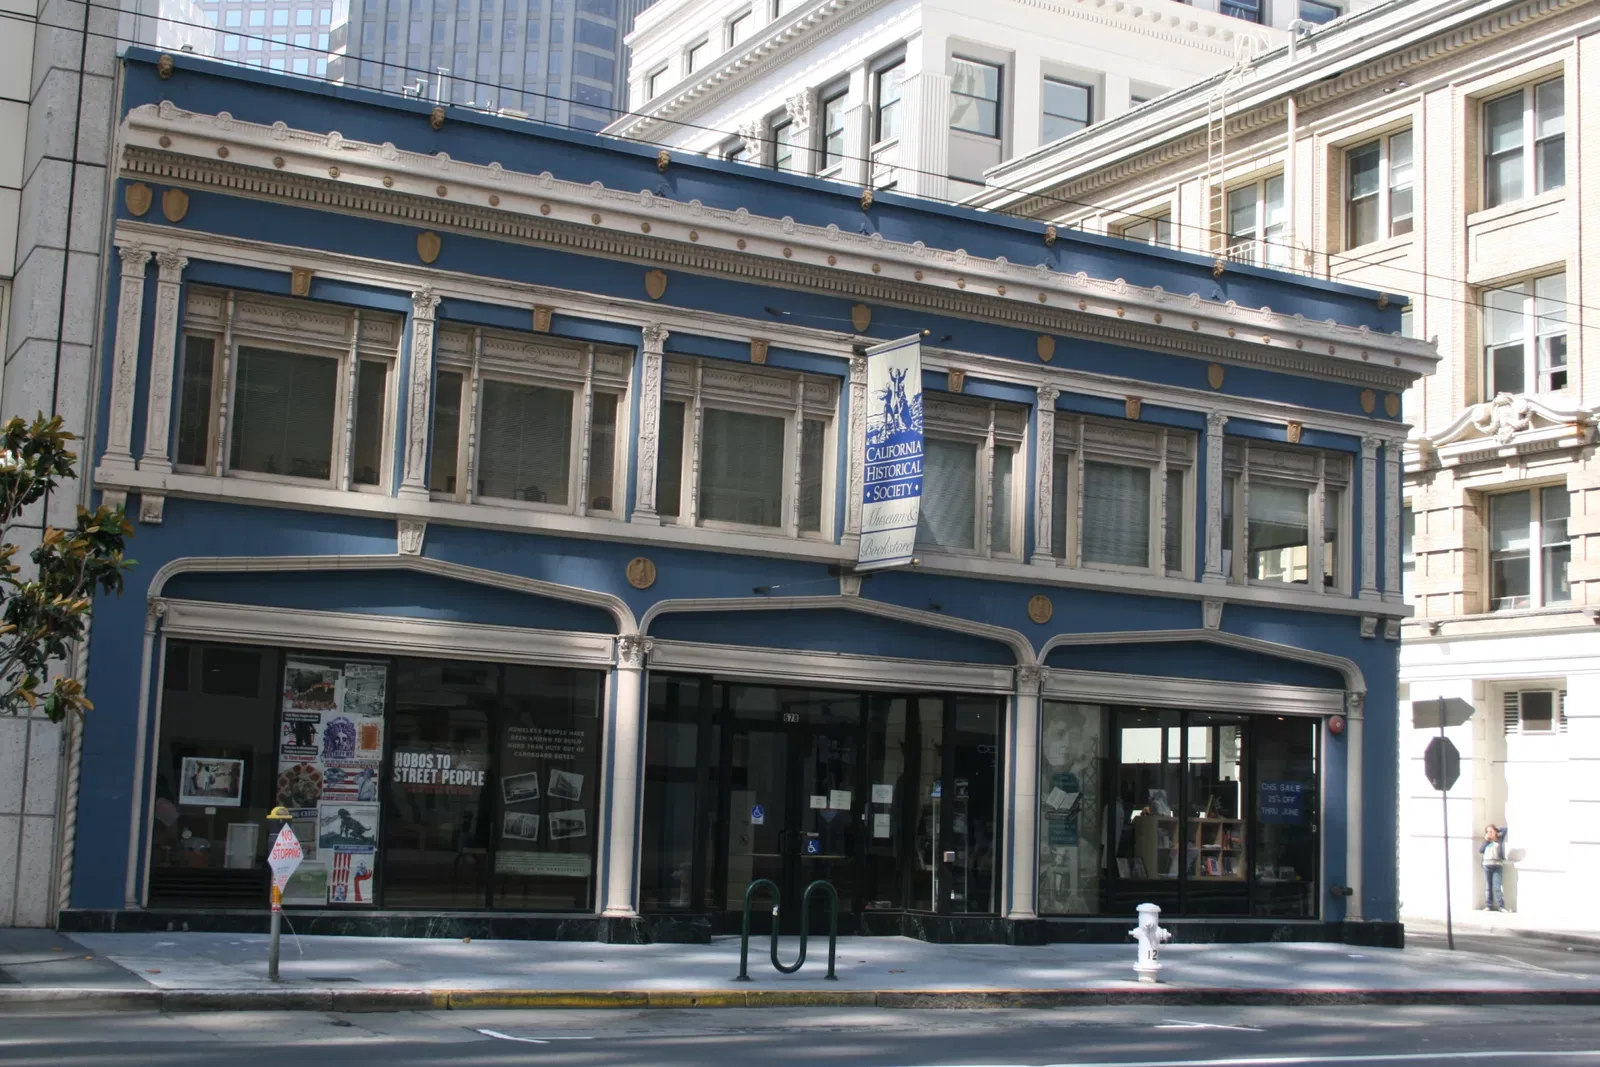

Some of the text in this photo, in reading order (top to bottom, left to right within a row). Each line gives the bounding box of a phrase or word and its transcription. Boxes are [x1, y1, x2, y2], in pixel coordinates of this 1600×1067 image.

[866, 440, 922, 462] CALIFORNIA
[866, 460, 922, 482] HISTORICAL
[873, 482, 913, 501] SOCIETY
[862, 506, 918, 528] Museum &
[860, 536, 913, 557] Bookstore
[784, 713, 799, 723] 678
[508, 727, 542, 735] HOMELESS
[544, 728, 567, 736] PEOPLE
[394, 752, 451, 769] HOBOS TO
[393, 767, 485, 786] STREET PEOPLE
[1279, 783, 1301, 792] SALE
[1282, 795, 1297, 804] OFF
[1261, 806, 1299, 816] THRU JUNE
[281, 830, 293, 841] NO
[272, 847, 301, 860] STOPPING
[1147, 949, 1158, 960] 12
